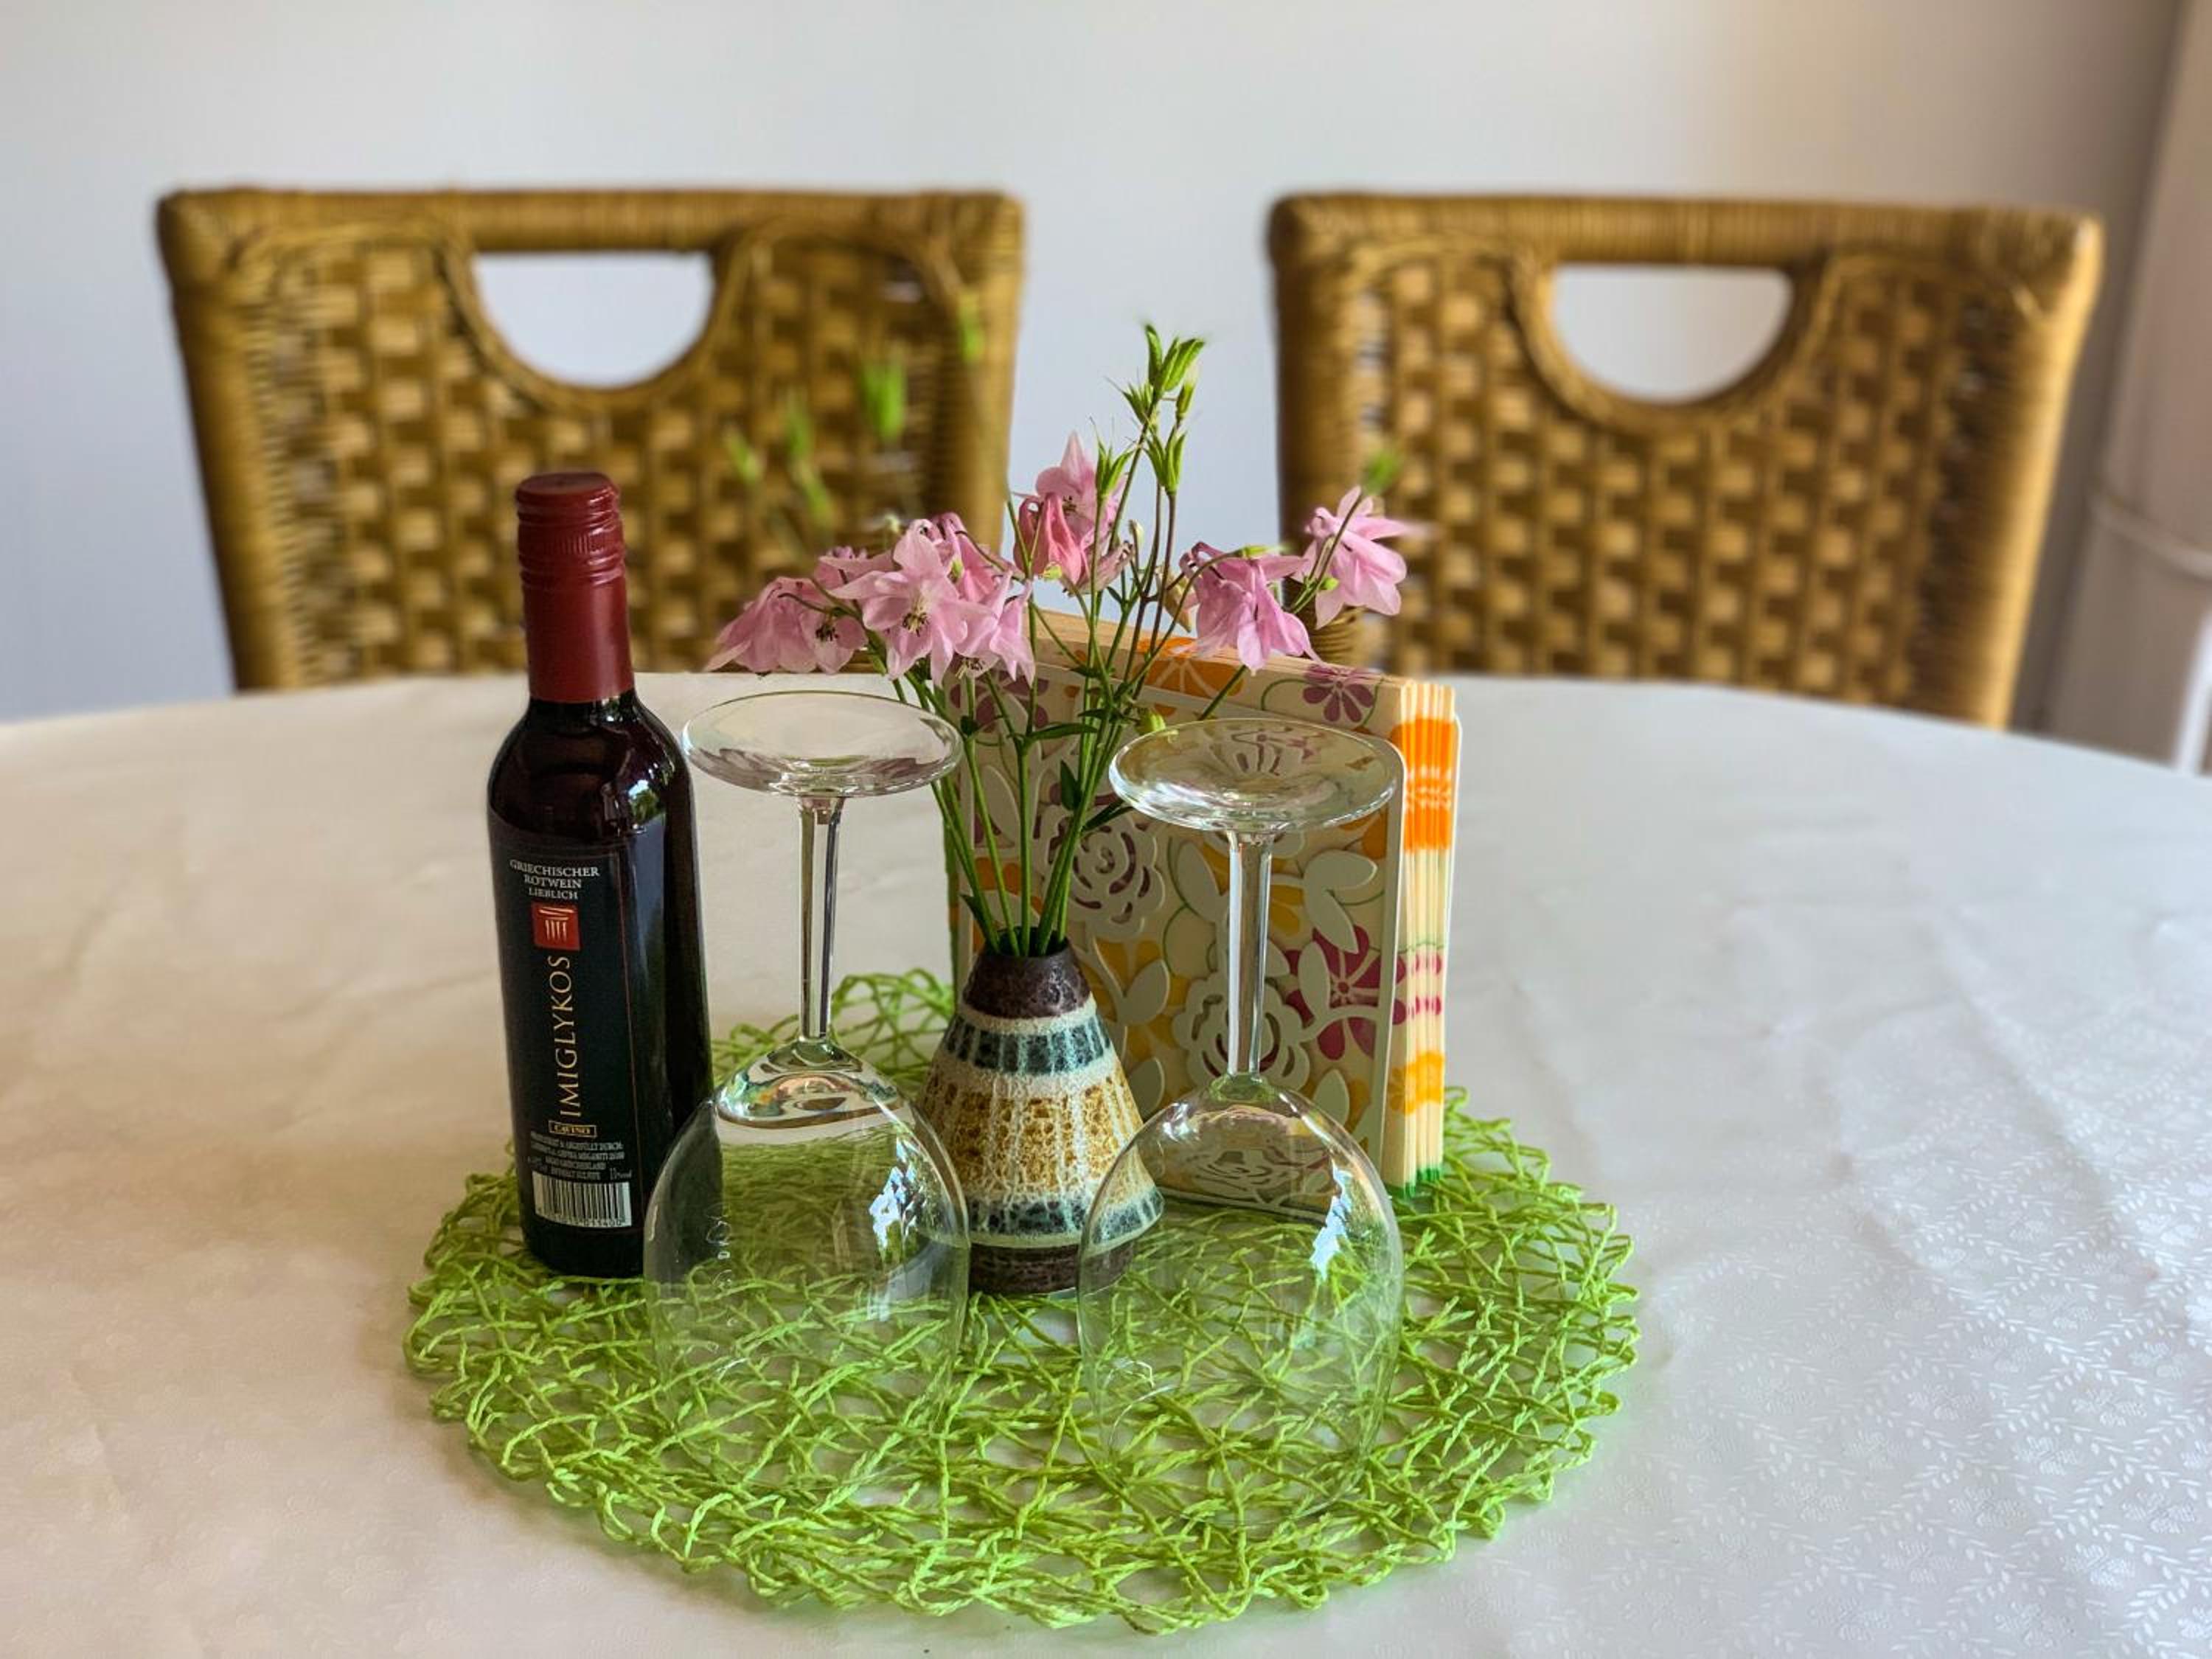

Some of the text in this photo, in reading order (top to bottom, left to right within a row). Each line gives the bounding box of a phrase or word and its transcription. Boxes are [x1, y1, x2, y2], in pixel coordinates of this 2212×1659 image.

[509, 859, 600, 877] GRIECHISCHER
[524, 874, 582, 888] ROTWEIN
[529, 887, 579, 900] LIEBLICH
[548, 956, 581, 1117] IMIGLYKOS
